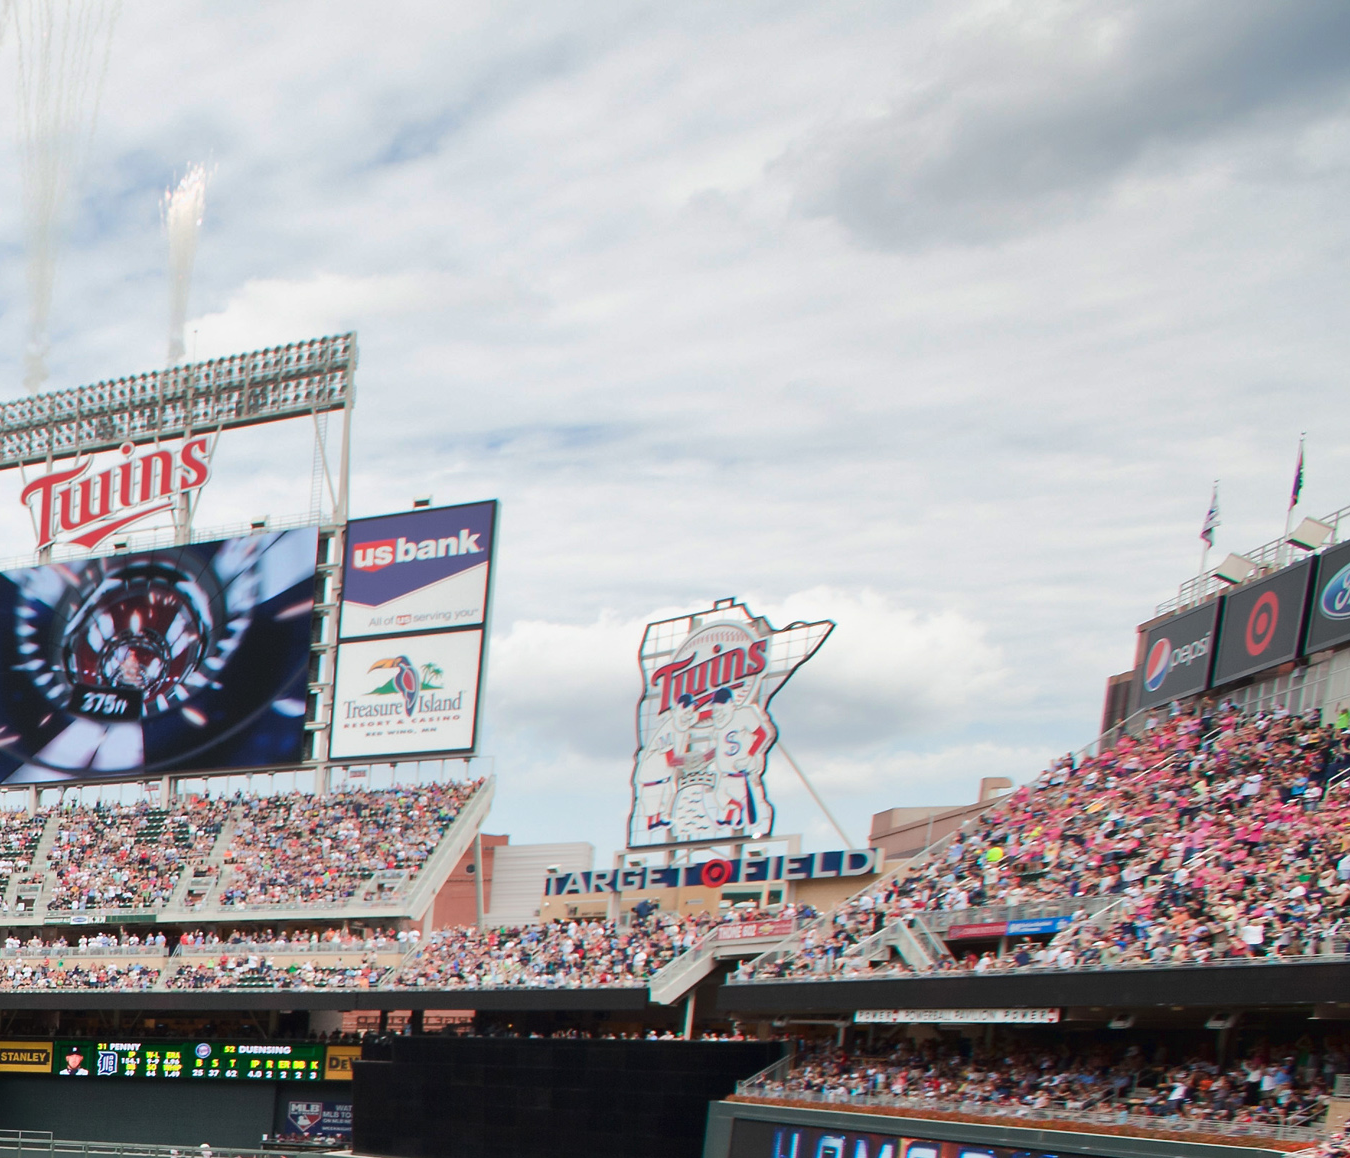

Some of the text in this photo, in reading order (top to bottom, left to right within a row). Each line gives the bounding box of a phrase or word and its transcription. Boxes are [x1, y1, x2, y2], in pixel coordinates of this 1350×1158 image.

[20, 437, 211, 550] Twins
[369, 617, 382, 627] All
[384, 616, 395, 626] of
[413, 611, 452, 624] serving
[1169, 631, 1212, 673] pepsi
[651, 638, 768, 716] Twins
[343, 690, 463, 719] Treasure Island
[343, 719, 391, 729] RESORT
[411, 714, 461, 724] CASINO
[546, 848, 878, 897] TARGET FIELD
[1004, 1010, 1047, 1020] POWER
[109, 1043, 141, 1051] PENNY
[238, 1046, 292, 1054] DUENSING
[0, 1052, 46, 1062] STANLEY
[310, 1061, 318, 1069] K
[192, 1069, 204, 1077] 25
[208, 1069, 220, 1077] 37
[266, 1070, 273, 1078] 2
[280, 1071, 287, 1079] 2
[291, 1103, 320, 1112] MLB
